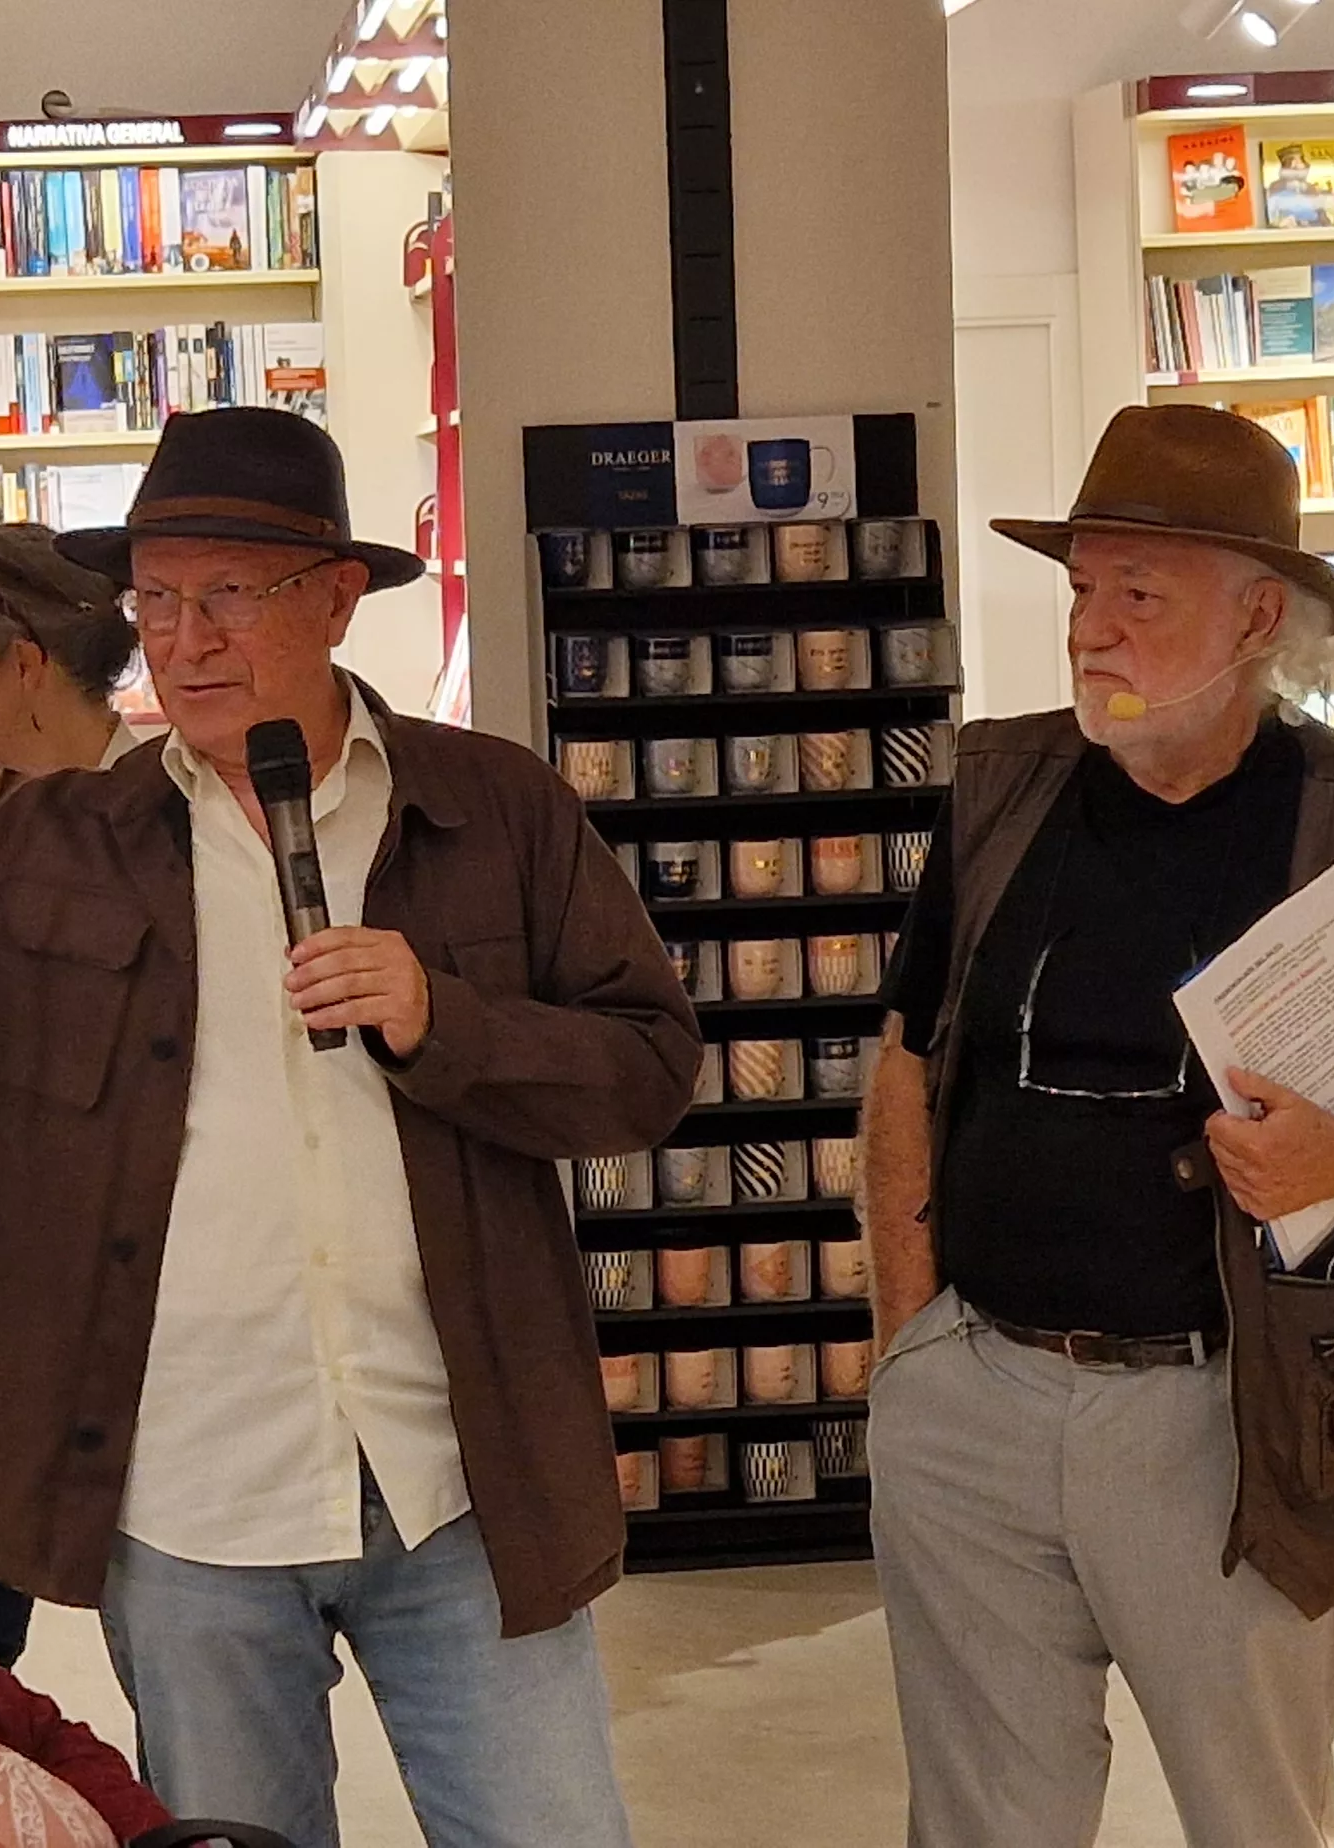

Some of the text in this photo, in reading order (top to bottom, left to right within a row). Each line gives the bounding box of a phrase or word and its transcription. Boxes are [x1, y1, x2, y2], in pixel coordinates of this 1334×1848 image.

[7, 121, 184, 148] NARRATIVA GENERAL
[591, 449, 671, 466] DRAEGER
